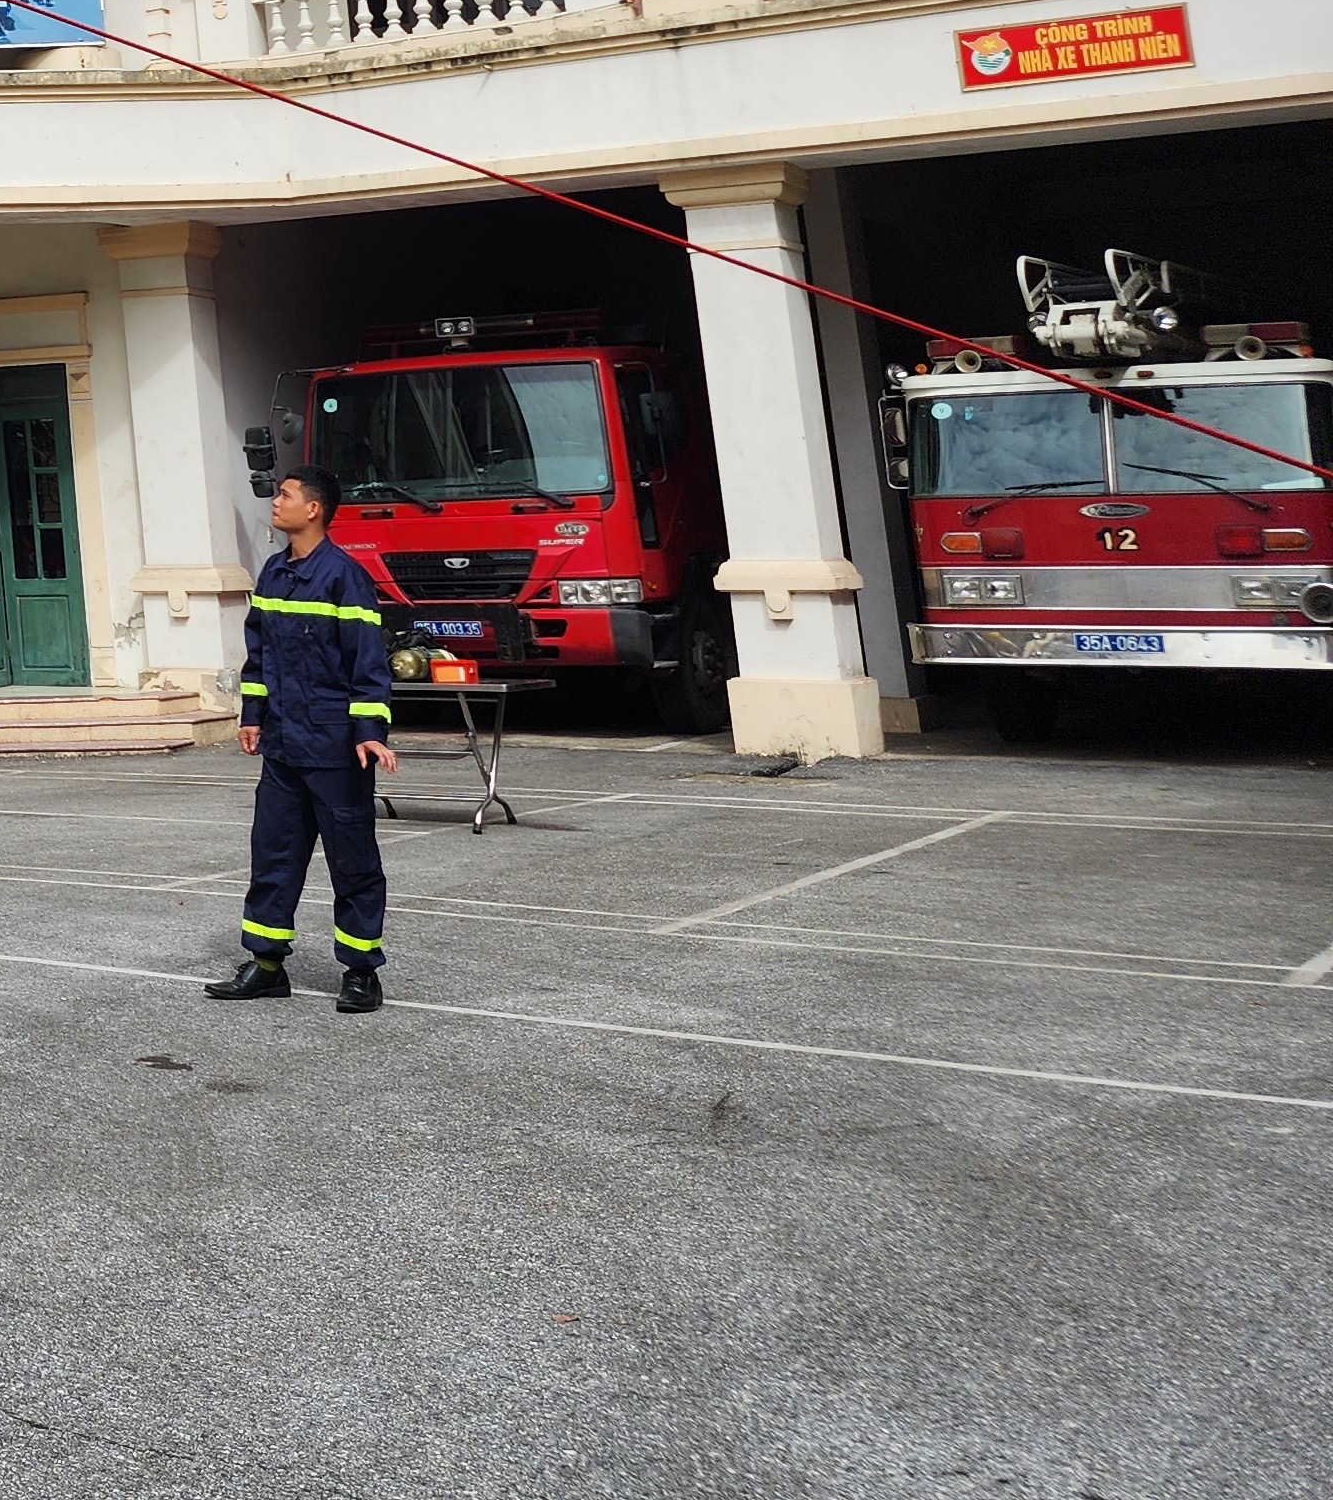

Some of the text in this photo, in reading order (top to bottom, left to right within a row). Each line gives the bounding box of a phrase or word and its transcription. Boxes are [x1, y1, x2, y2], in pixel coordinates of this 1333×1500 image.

[1035, 15, 1152, 46] CÔNG TRÌNH
[1018, 31, 1181, 74] NHÀ XE THANH NIÊN
[538, 538, 584, 546] SUPER
[1103, 529, 1139, 550] 12
